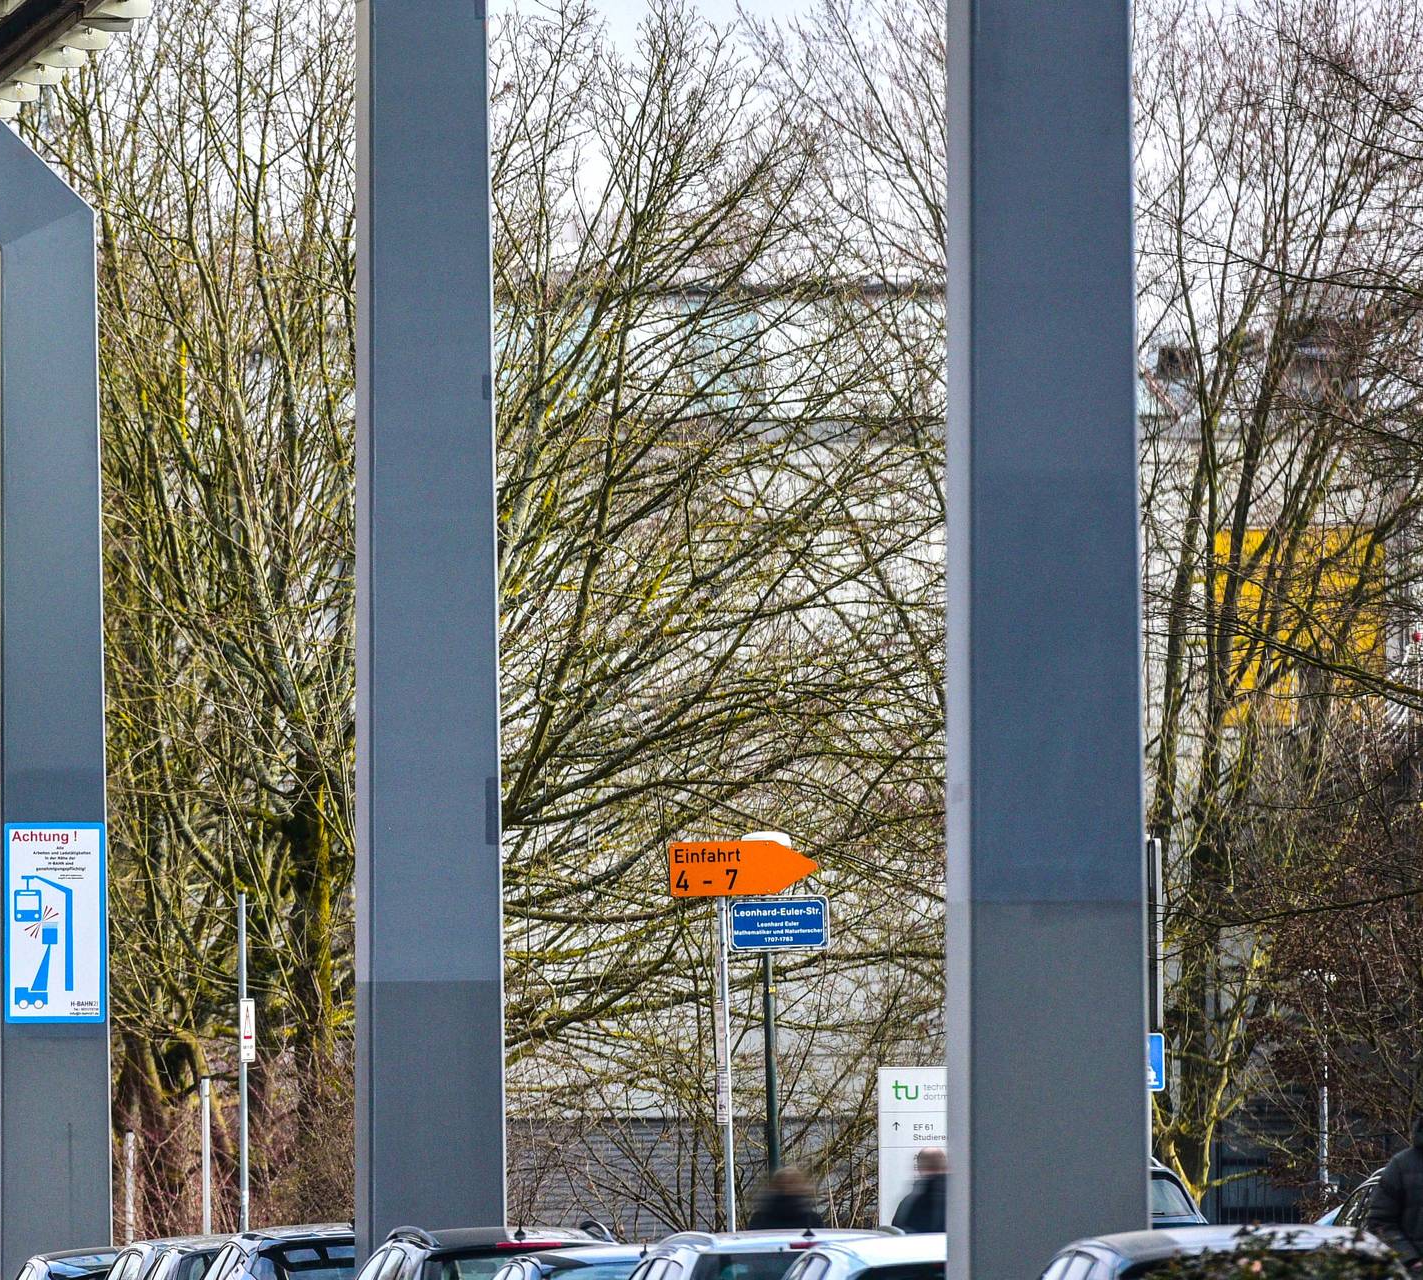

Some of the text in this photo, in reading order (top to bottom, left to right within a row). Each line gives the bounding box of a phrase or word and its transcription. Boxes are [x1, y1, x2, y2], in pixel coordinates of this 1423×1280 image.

[12, 831, 69, 845] Achtung
[674, 848, 741, 864] Einfahrt
[675, 870, 689, 891] 4
[725, 869, 738, 890] 7
[734, 907, 821, 917] Leonhard-Euler-Str.
[892, 1080, 919, 1100] tu
[913, 1123, 934, 1131] EF 61
